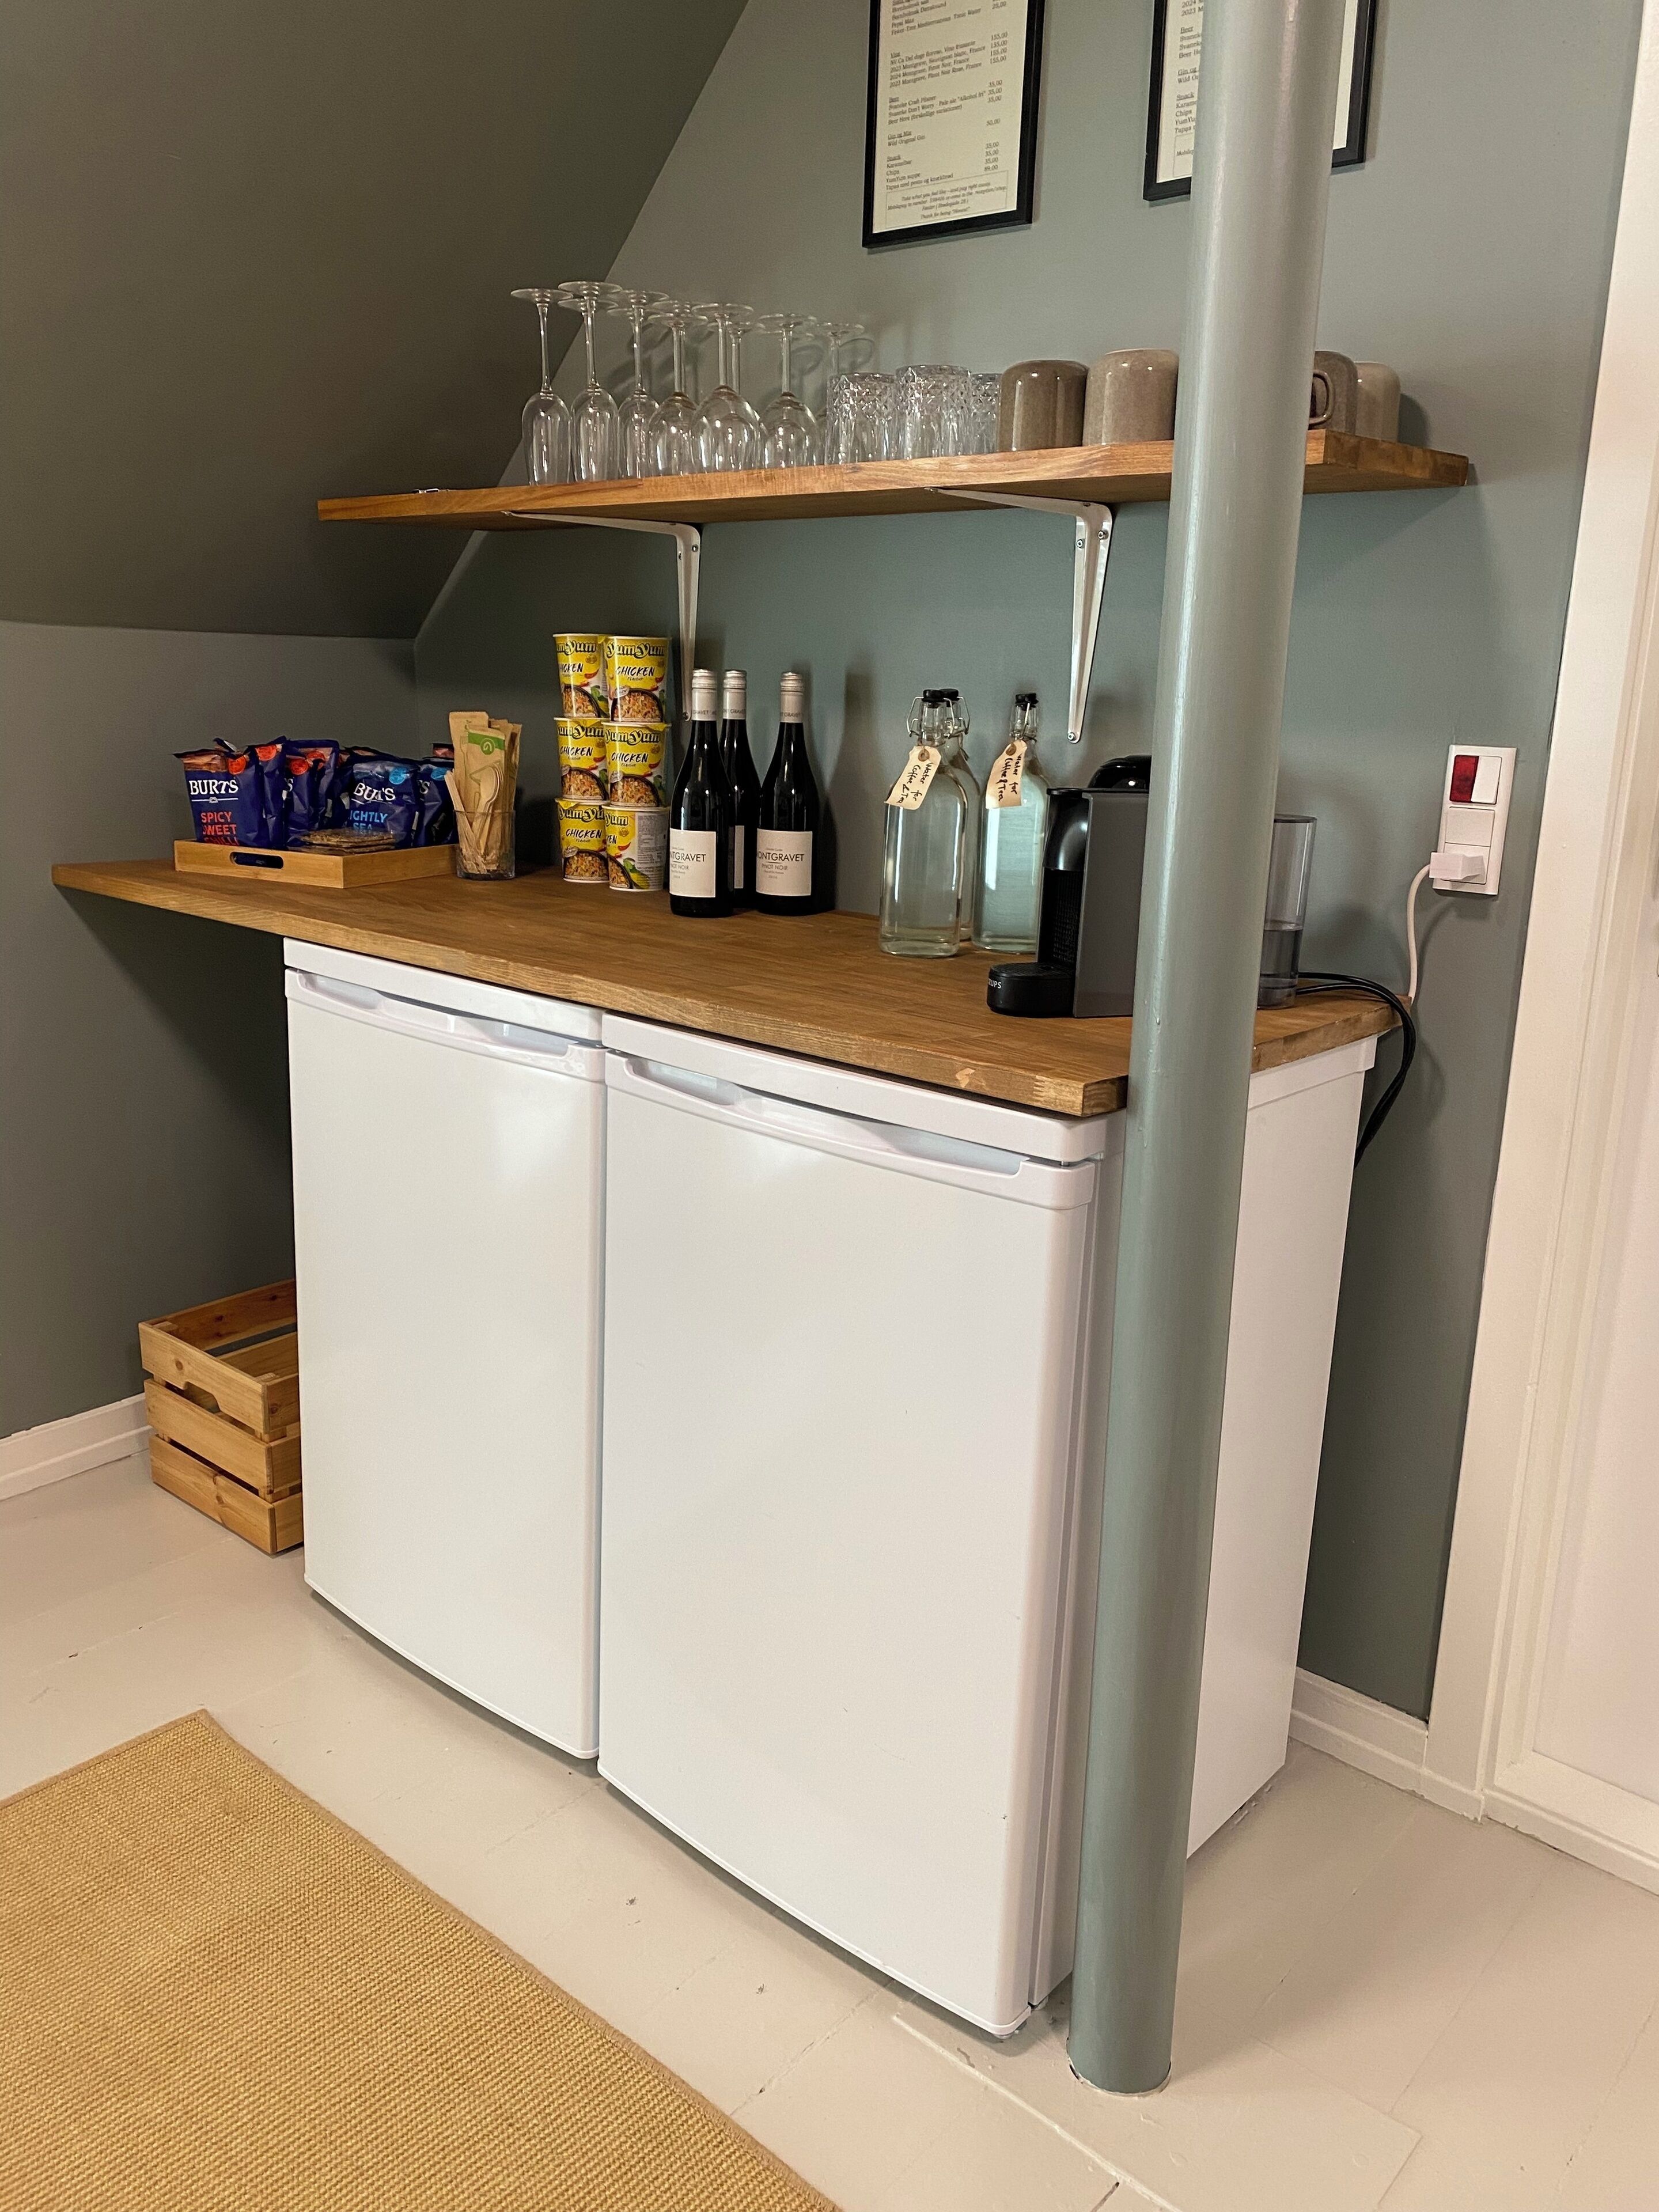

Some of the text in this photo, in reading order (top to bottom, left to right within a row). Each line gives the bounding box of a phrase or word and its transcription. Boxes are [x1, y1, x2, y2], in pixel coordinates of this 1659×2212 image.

[1175, 109, 1192, 118] Chips
[1175, 116, 1195, 126] YumYu
[615, 666, 655, 677] CHICKEN
[559, 745, 593, 757] CHICKEN
[611, 752, 649, 763] CHICKEN
[188, 779, 239, 795] BURTS
[200, 811, 232, 823] SPICY
[349, 810, 388, 823] IGHTLY
[559, 808, 605, 823] YumYu
[565, 828, 603, 839] CHICKEN
[757, 851, 805, 862] ONTGRAVET
